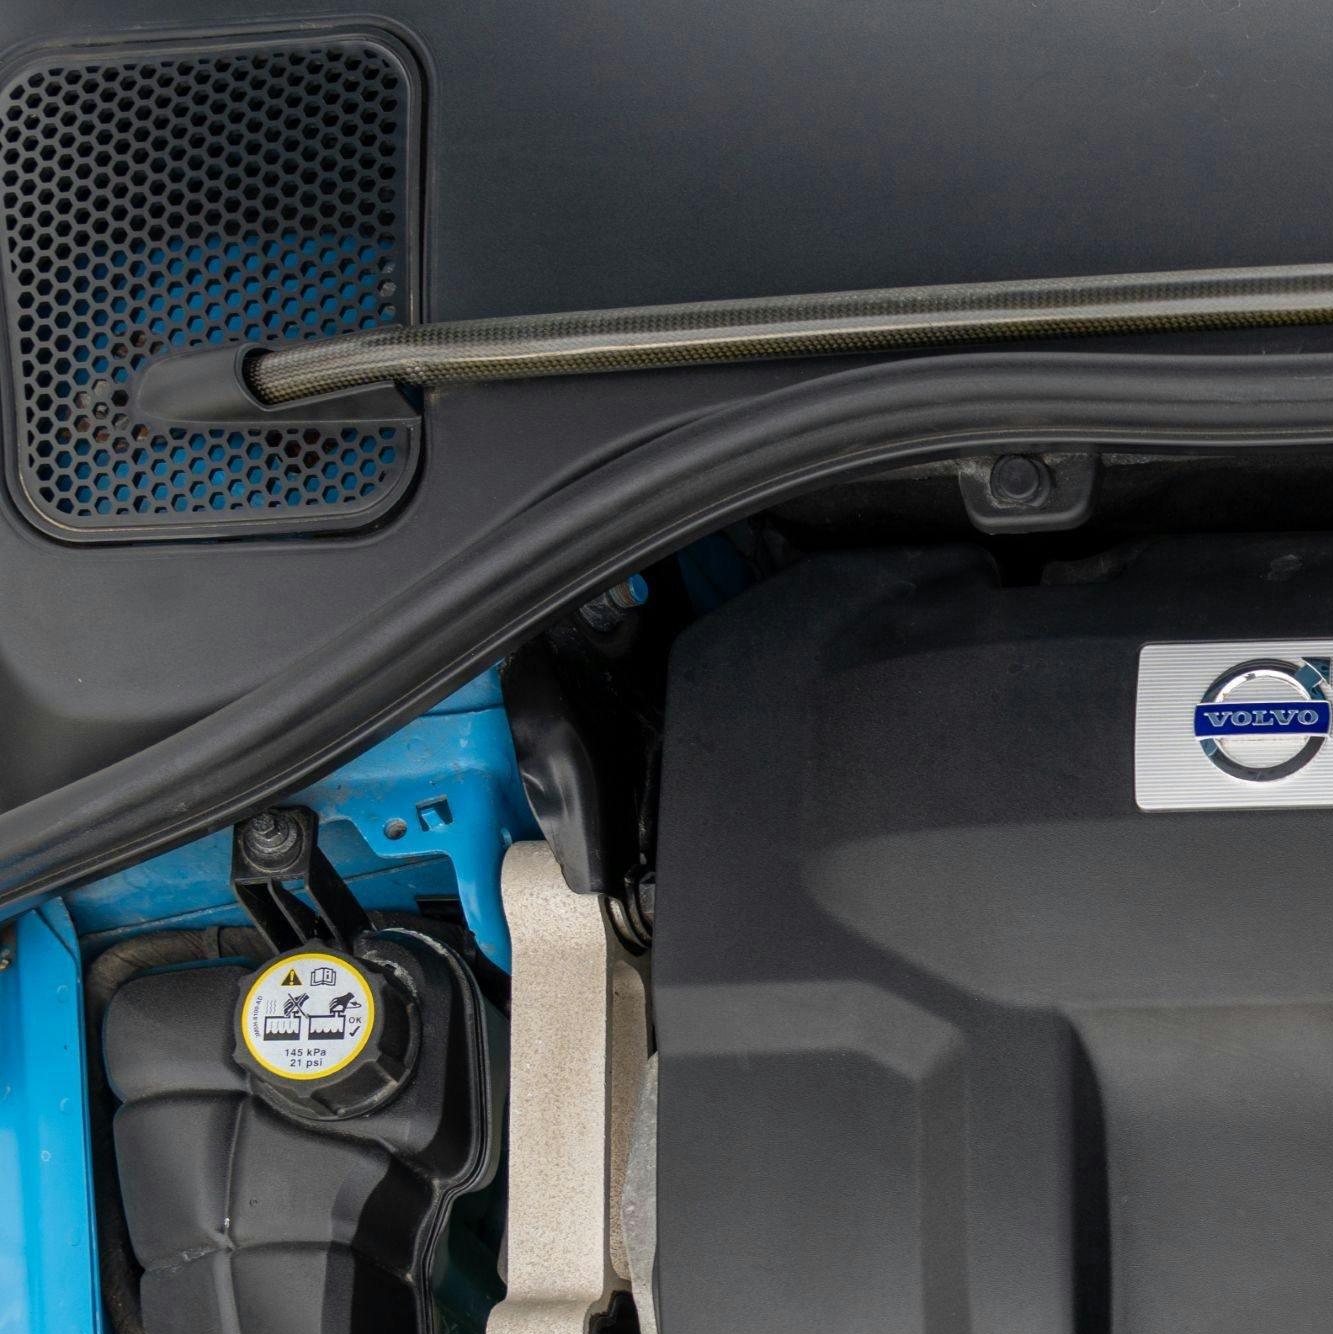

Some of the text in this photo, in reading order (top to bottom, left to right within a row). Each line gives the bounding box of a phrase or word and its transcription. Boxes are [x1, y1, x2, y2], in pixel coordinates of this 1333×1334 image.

[1203, 707, 1319, 727] VOLVO
[348, 1016, 362, 1024] OK
[307, 1048, 326, 1056] kPa
[290, 1059, 323, 1068] 21 psi
